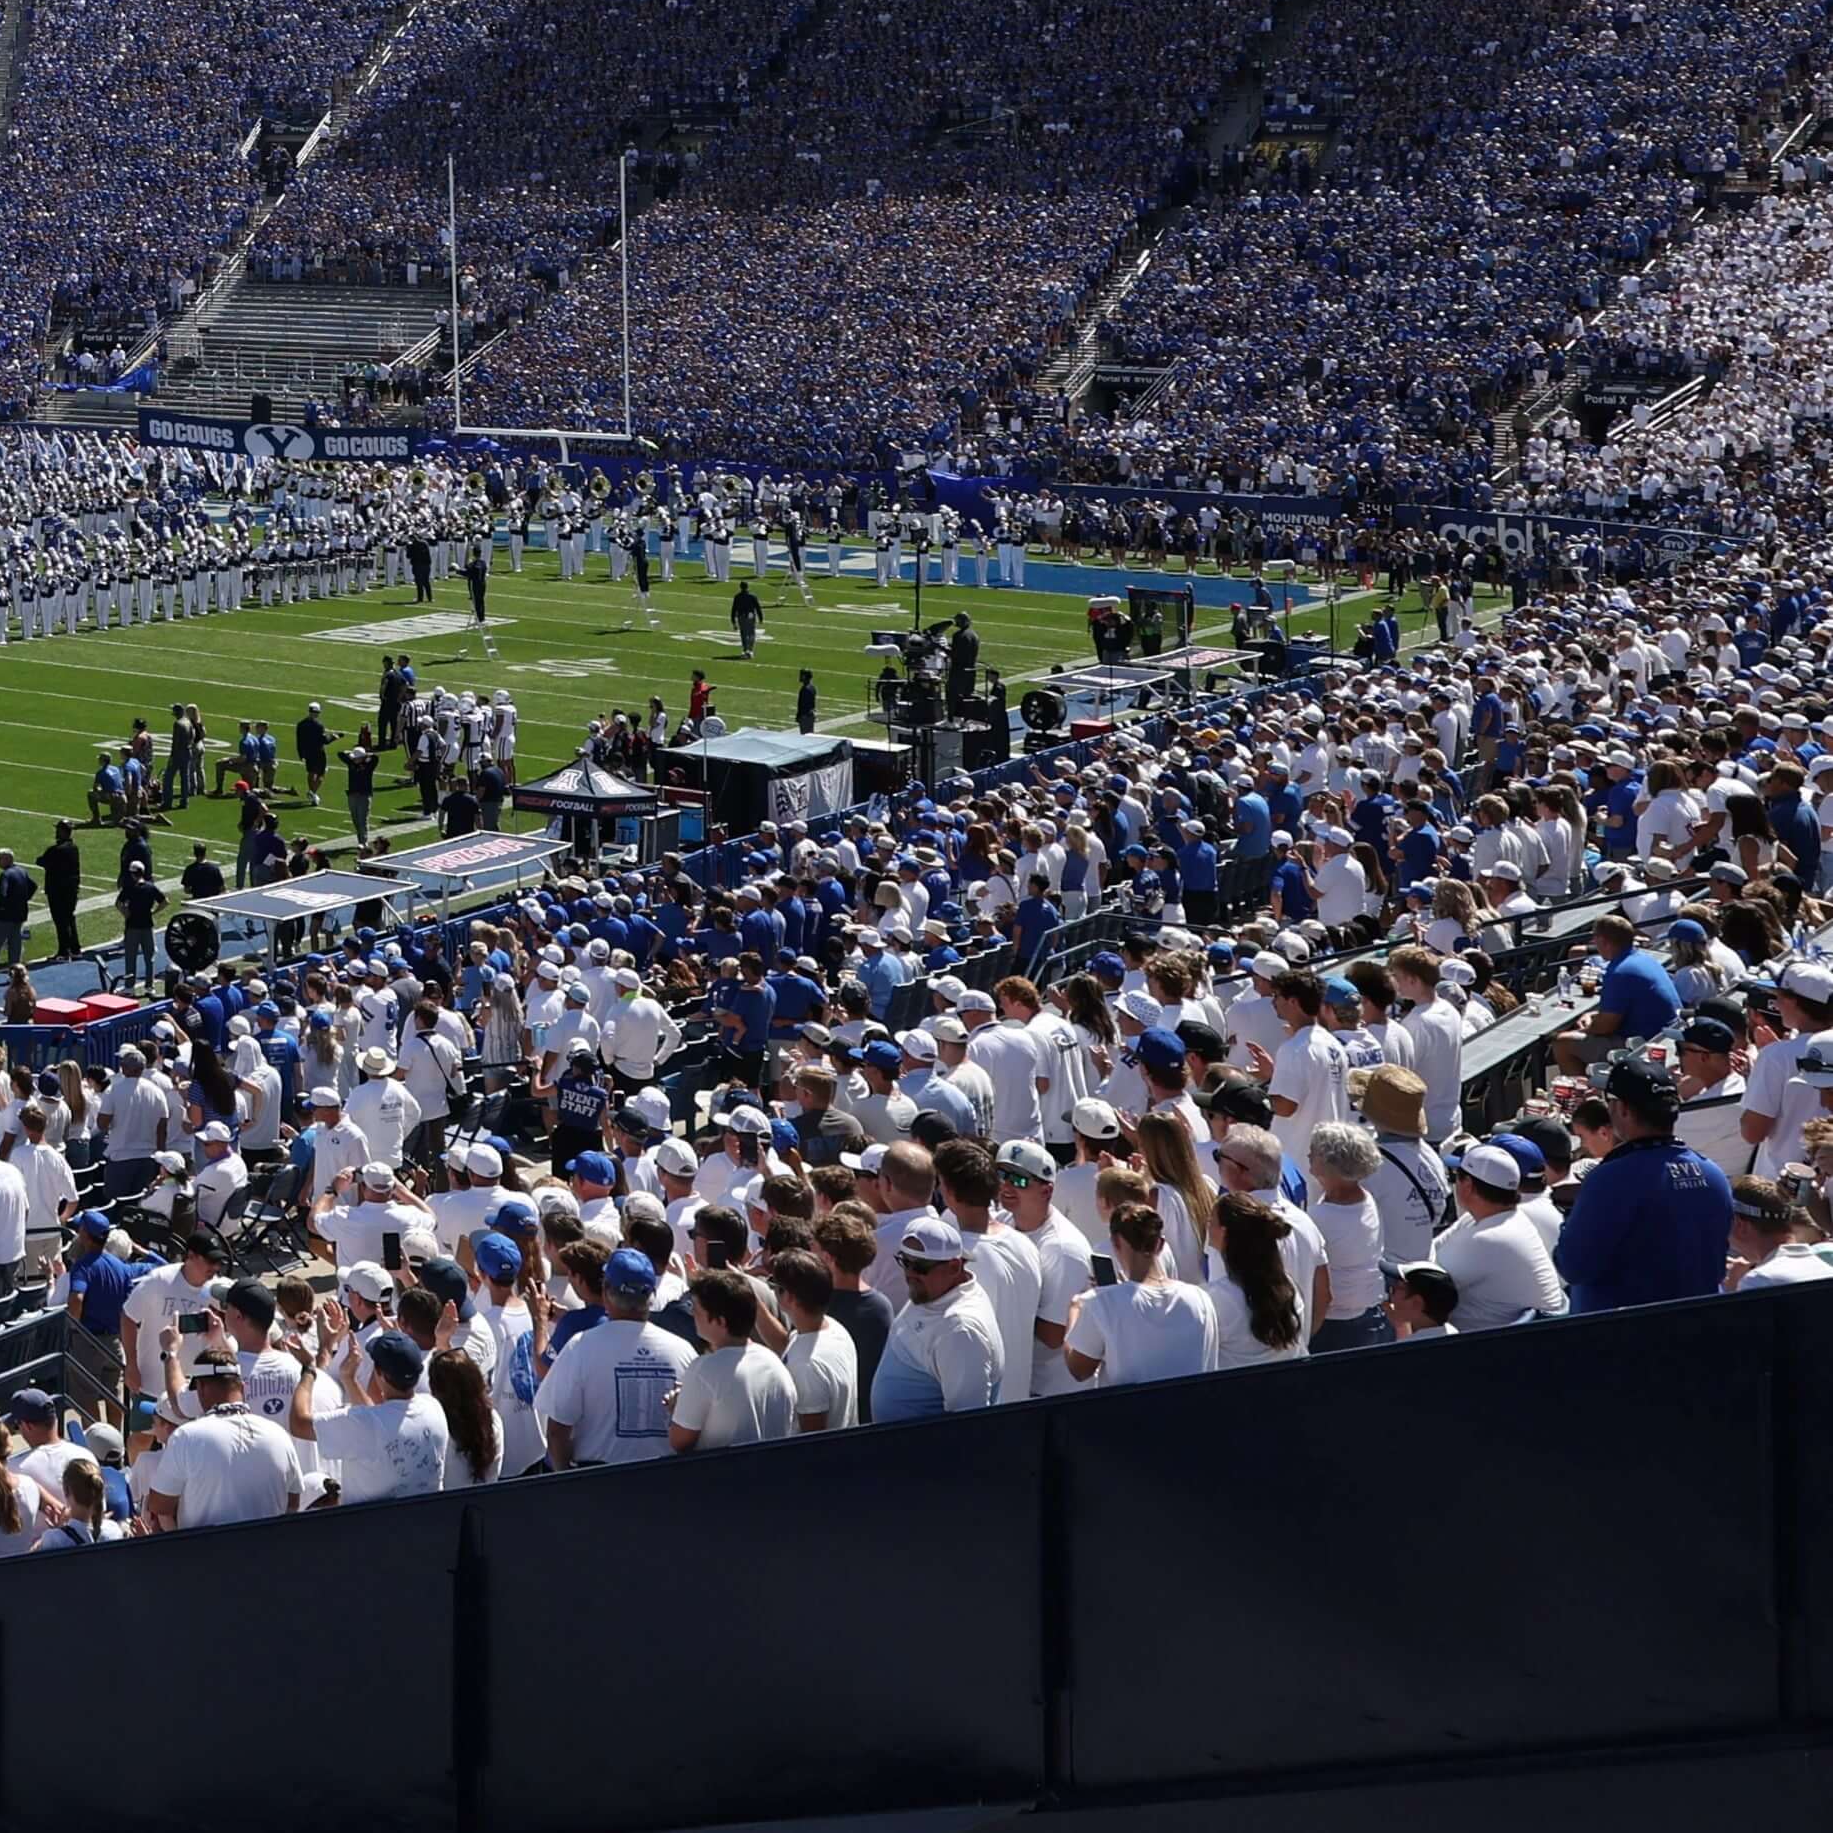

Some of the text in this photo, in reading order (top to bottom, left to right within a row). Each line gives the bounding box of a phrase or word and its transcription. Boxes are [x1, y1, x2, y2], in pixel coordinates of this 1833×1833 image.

[1097, 374, 1120, 383] Portal
[1584, 394, 1627, 406] Portal X
[149, 419, 234, 449] GO COUGS
[324, 436, 409, 456] GO COUGS
[1358, 501, 1393, 517] 3:44
[1261, 512, 1331, 527] MOUNTAIN
[543, 769, 584, 792] A
[549, 798, 595, 813] FOOTBALL
[561, 1089, 600, 1109] EVENT
[559, 1100, 597, 1118] STAFF
[1665, 1162, 1702, 1179] BYU
